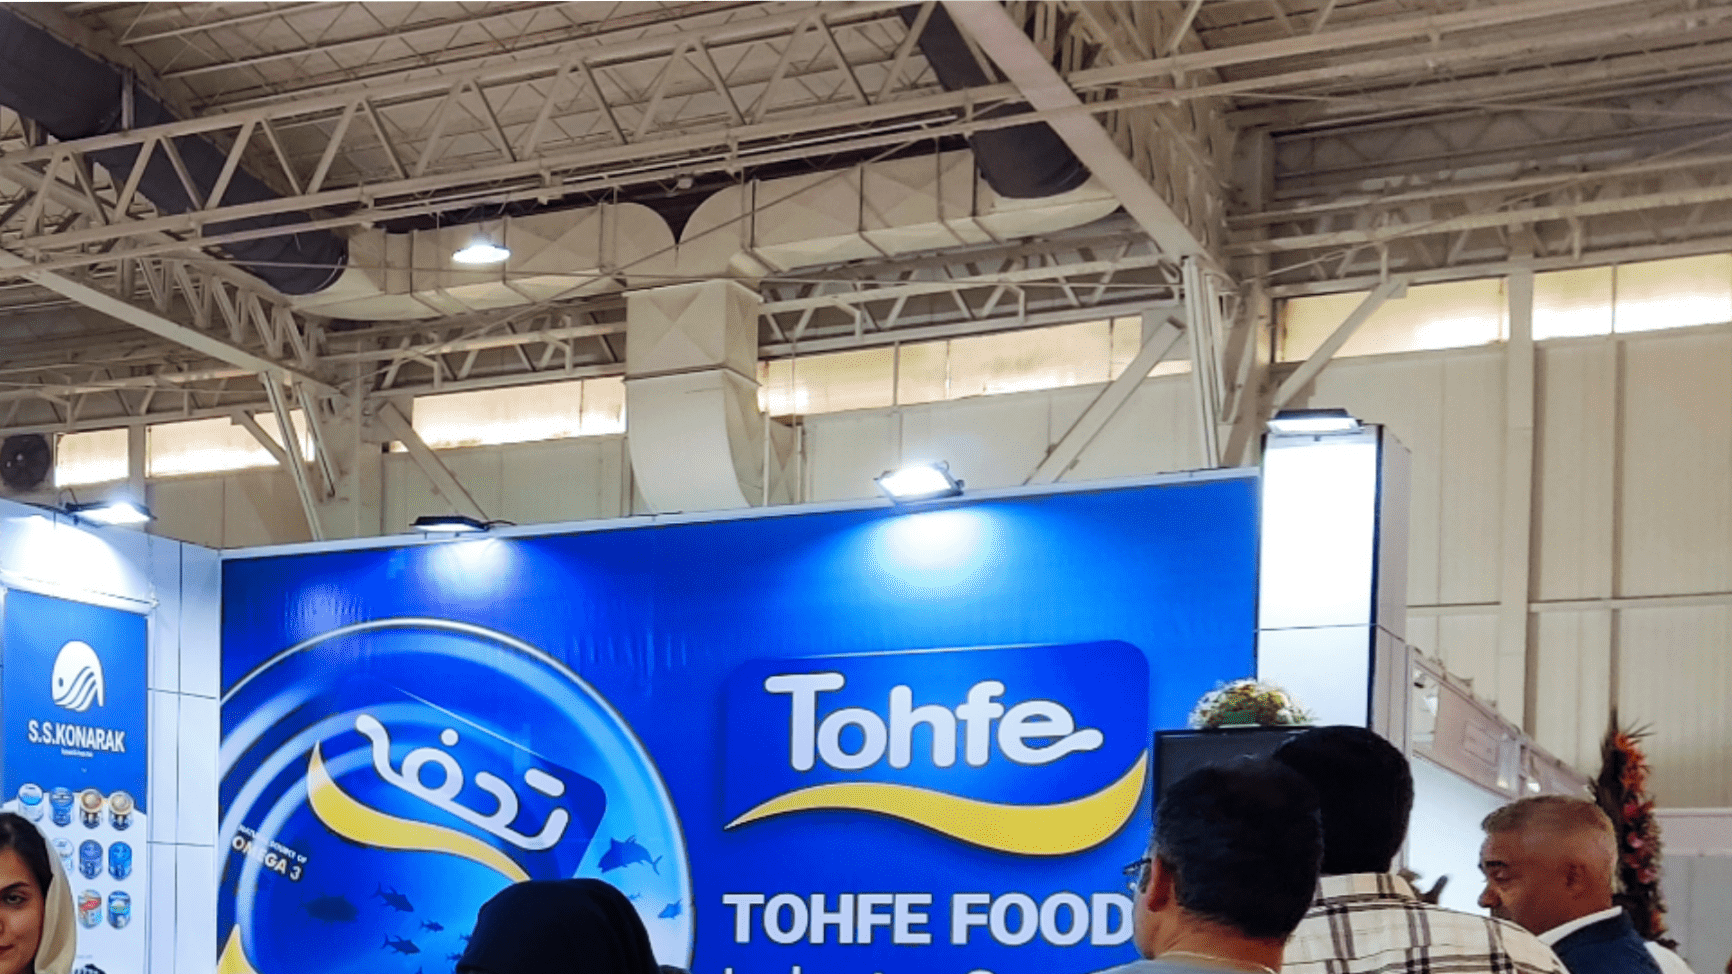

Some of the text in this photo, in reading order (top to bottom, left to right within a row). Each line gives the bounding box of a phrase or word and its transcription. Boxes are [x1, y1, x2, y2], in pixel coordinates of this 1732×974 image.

[28, 719, 126, 753] S.S.KONARAK
[765, 671, 1104, 772] Tohfe
[289, 865, 302, 881] 3
[722, 893, 1135, 946] TOHFE FOOD
